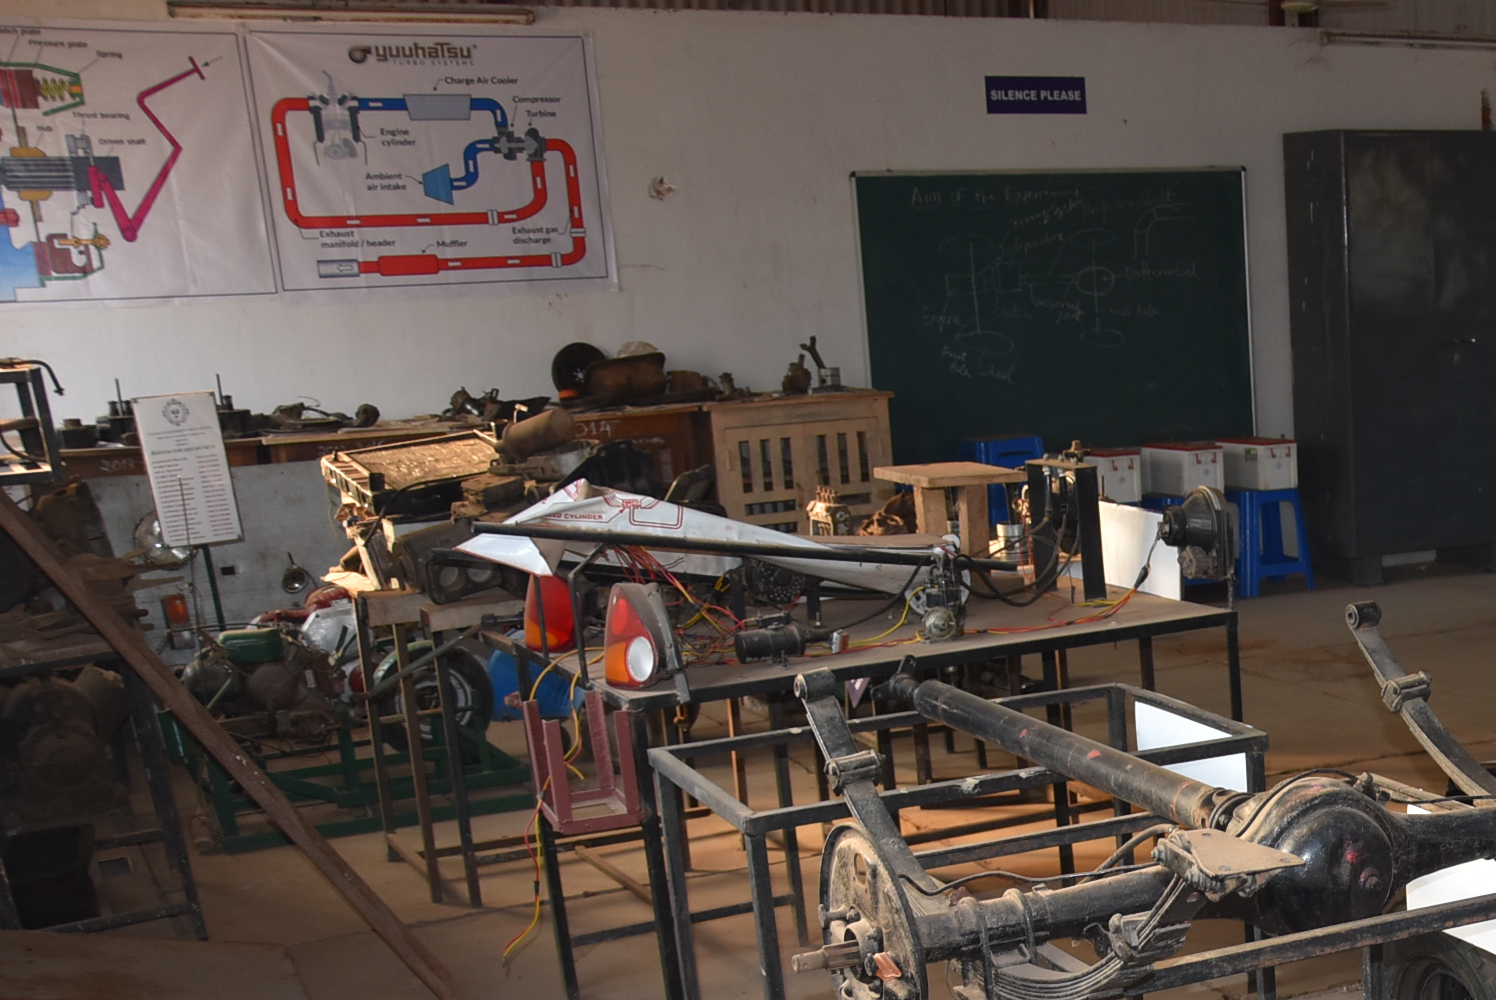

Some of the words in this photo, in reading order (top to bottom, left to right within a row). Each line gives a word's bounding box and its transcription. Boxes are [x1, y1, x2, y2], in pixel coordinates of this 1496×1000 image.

[28, 39, 65, 48] Pressure
[67, 40, 88, 48] plate
[95, 50, 123, 59] Spring
[444, 76, 475, 85] Charge
[490, 76, 518, 85] Cooler
[512, 95, 562, 104] Compressor
[990, 89, 1038, 101] SILENCE
[1040, 89, 1082, 101] PLEASE
[100, 112, 130, 120] bearing
[525, 109, 557, 118] Turbine
[379, 128, 410, 137] Engine
[381, 138, 416, 147] cylinder
[365, 172, 402, 180] Ambient
[319, 230, 355, 238] Exhaust
[512, 226, 544, 234] Exhaust
[545, 227, 559, 235] gas
[320, 240, 359, 248] manifold
[365, 239, 396, 247] header
[436, 240, 468, 248] Muffler
[512, 236, 552, 245] discharge
[575, 420, 613, 438] 014
